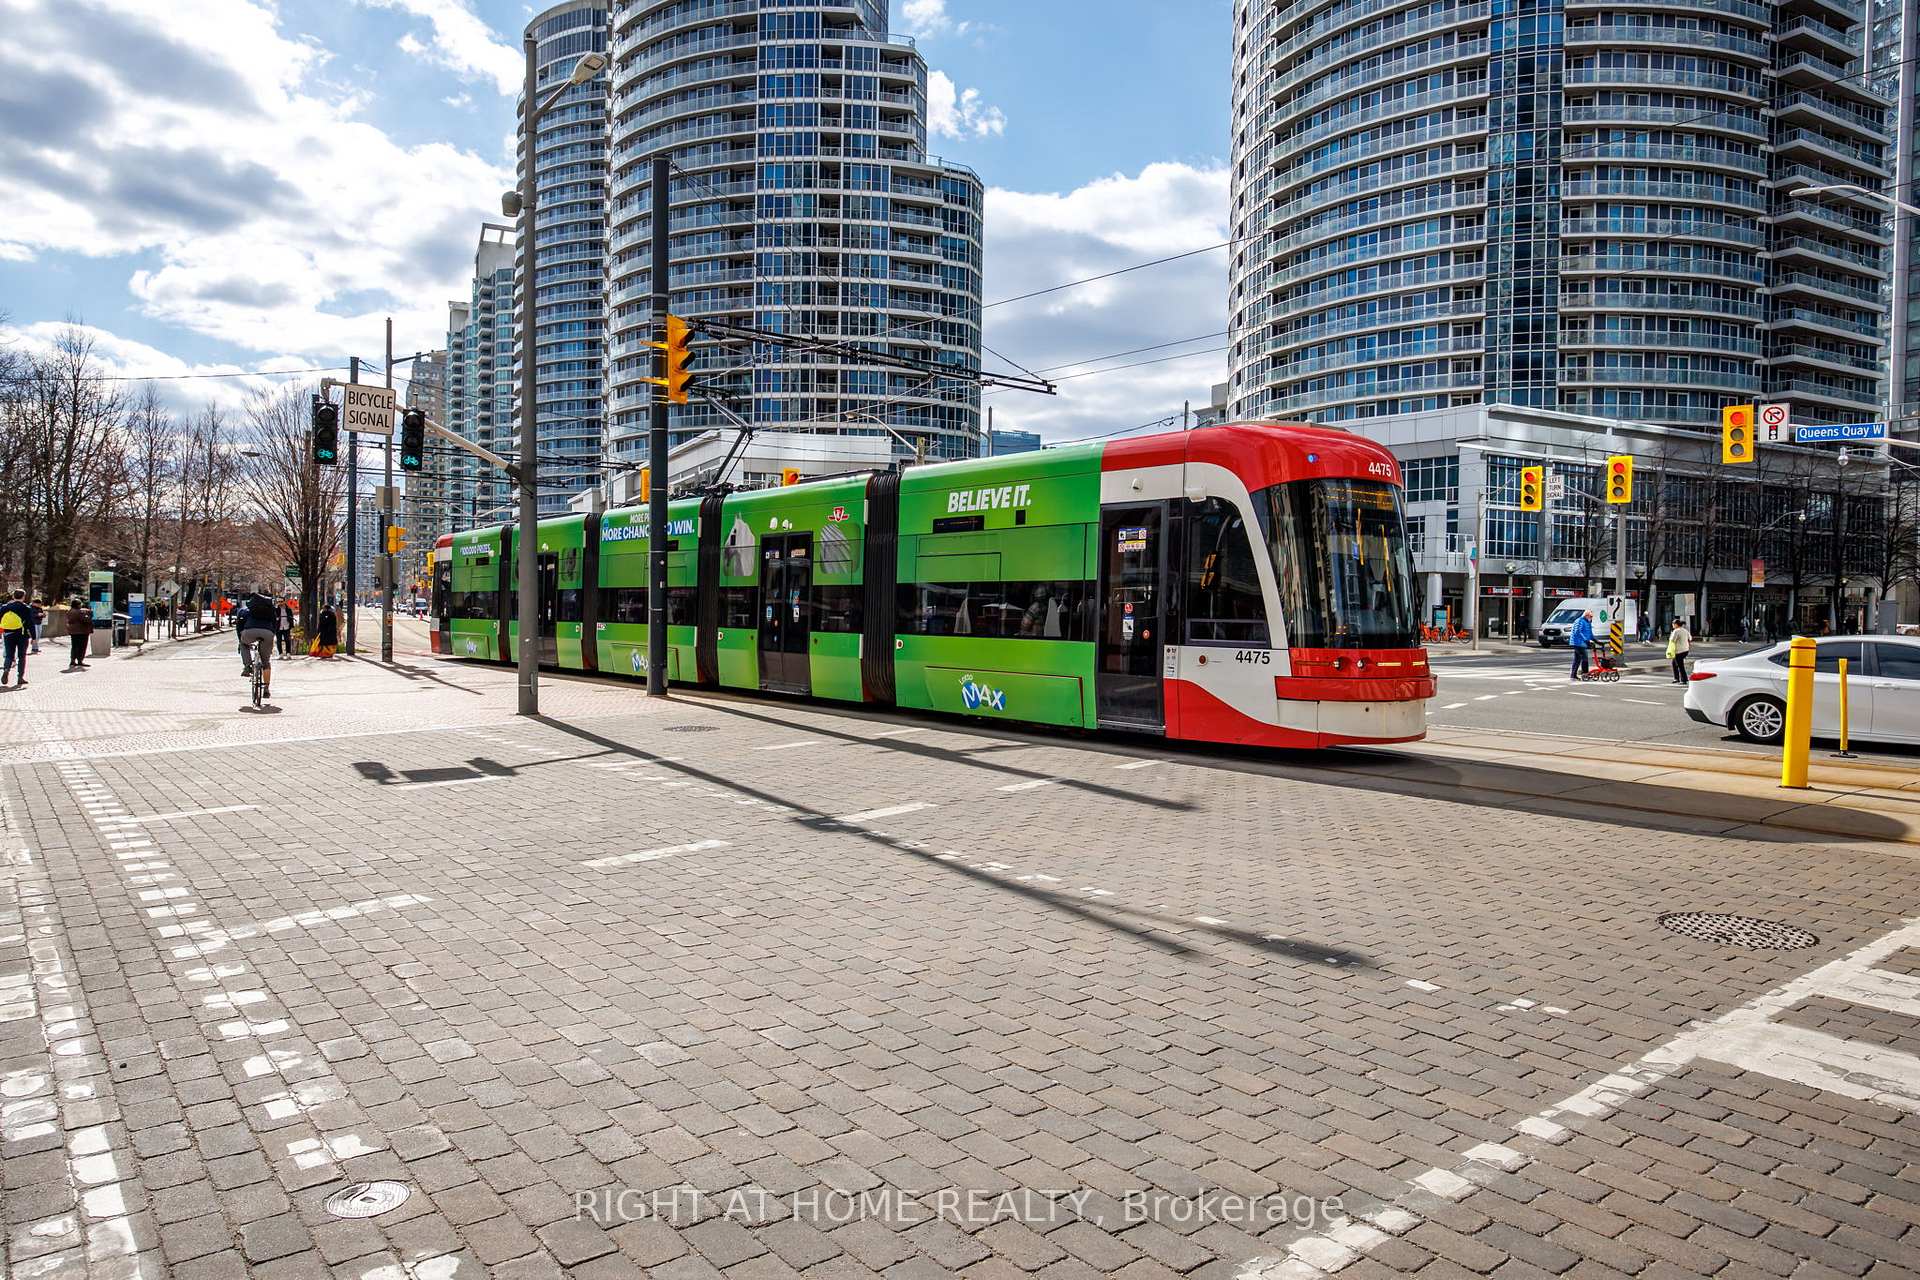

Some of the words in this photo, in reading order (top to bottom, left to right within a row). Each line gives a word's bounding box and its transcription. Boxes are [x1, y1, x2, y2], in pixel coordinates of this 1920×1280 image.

[349, 391, 393, 409] BICYCLE
[349, 410, 390, 428] SIGNAL
[1799, 427, 1839, 438] Queens
[1842, 426, 1870, 438] Quay
[1872, 425, 1882, 435] W
[1368, 462, 1392, 477] 4475
[947, 486, 1013, 513] BELIEVE
[1013, 484, 1032, 507] IT.
[601, 526, 622, 541] MORE
[622, 524, 650, 540] CHANC
[674, 519, 695, 535] WIN.
[1235, 650, 1271, 665] 4475
[962, 682, 1004, 711] MAX
